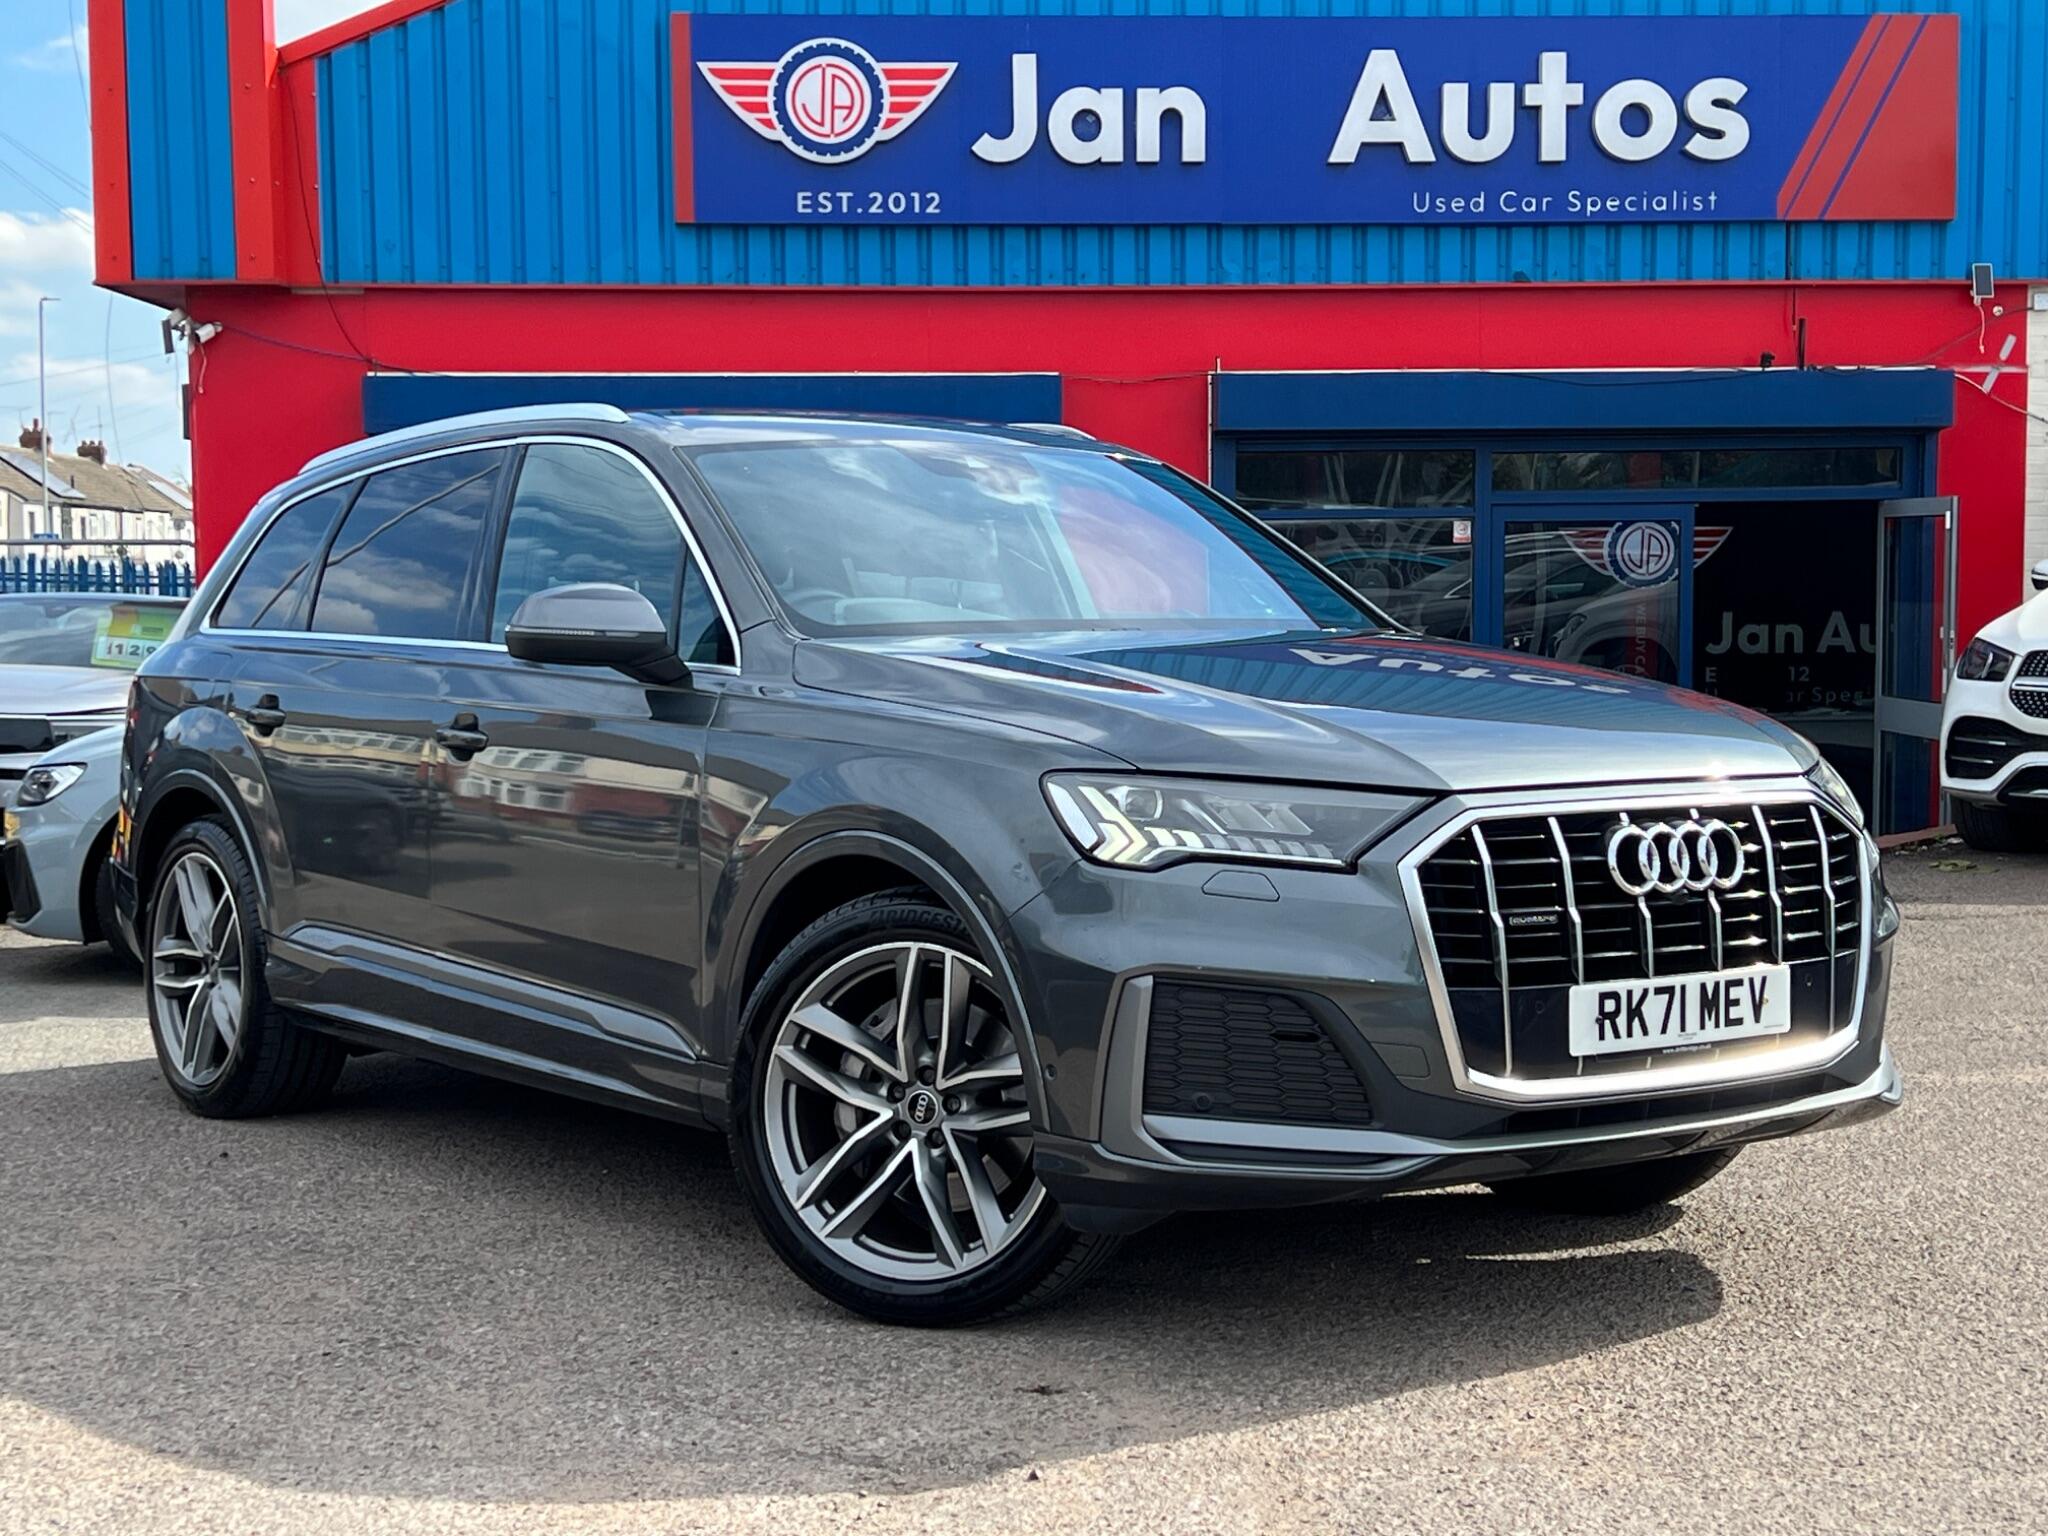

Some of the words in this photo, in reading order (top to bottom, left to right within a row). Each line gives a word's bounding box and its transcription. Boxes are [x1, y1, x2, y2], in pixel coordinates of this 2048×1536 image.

[970, 53, 1206, 164] Jan
[1326, 49, 1750, 163] Autos
[796, 192, 941, 214] EST.2012
[1411, 190, 1485, 214] Used
[1499, 191, 1553, 213] Car
[1566, 190, 1719, 217] Specialist
[1705, 611, 1804, 654] Jan
[1598, 984, 1687, 1041] RK71
[1699, 975, 1768, 1030] MEV
